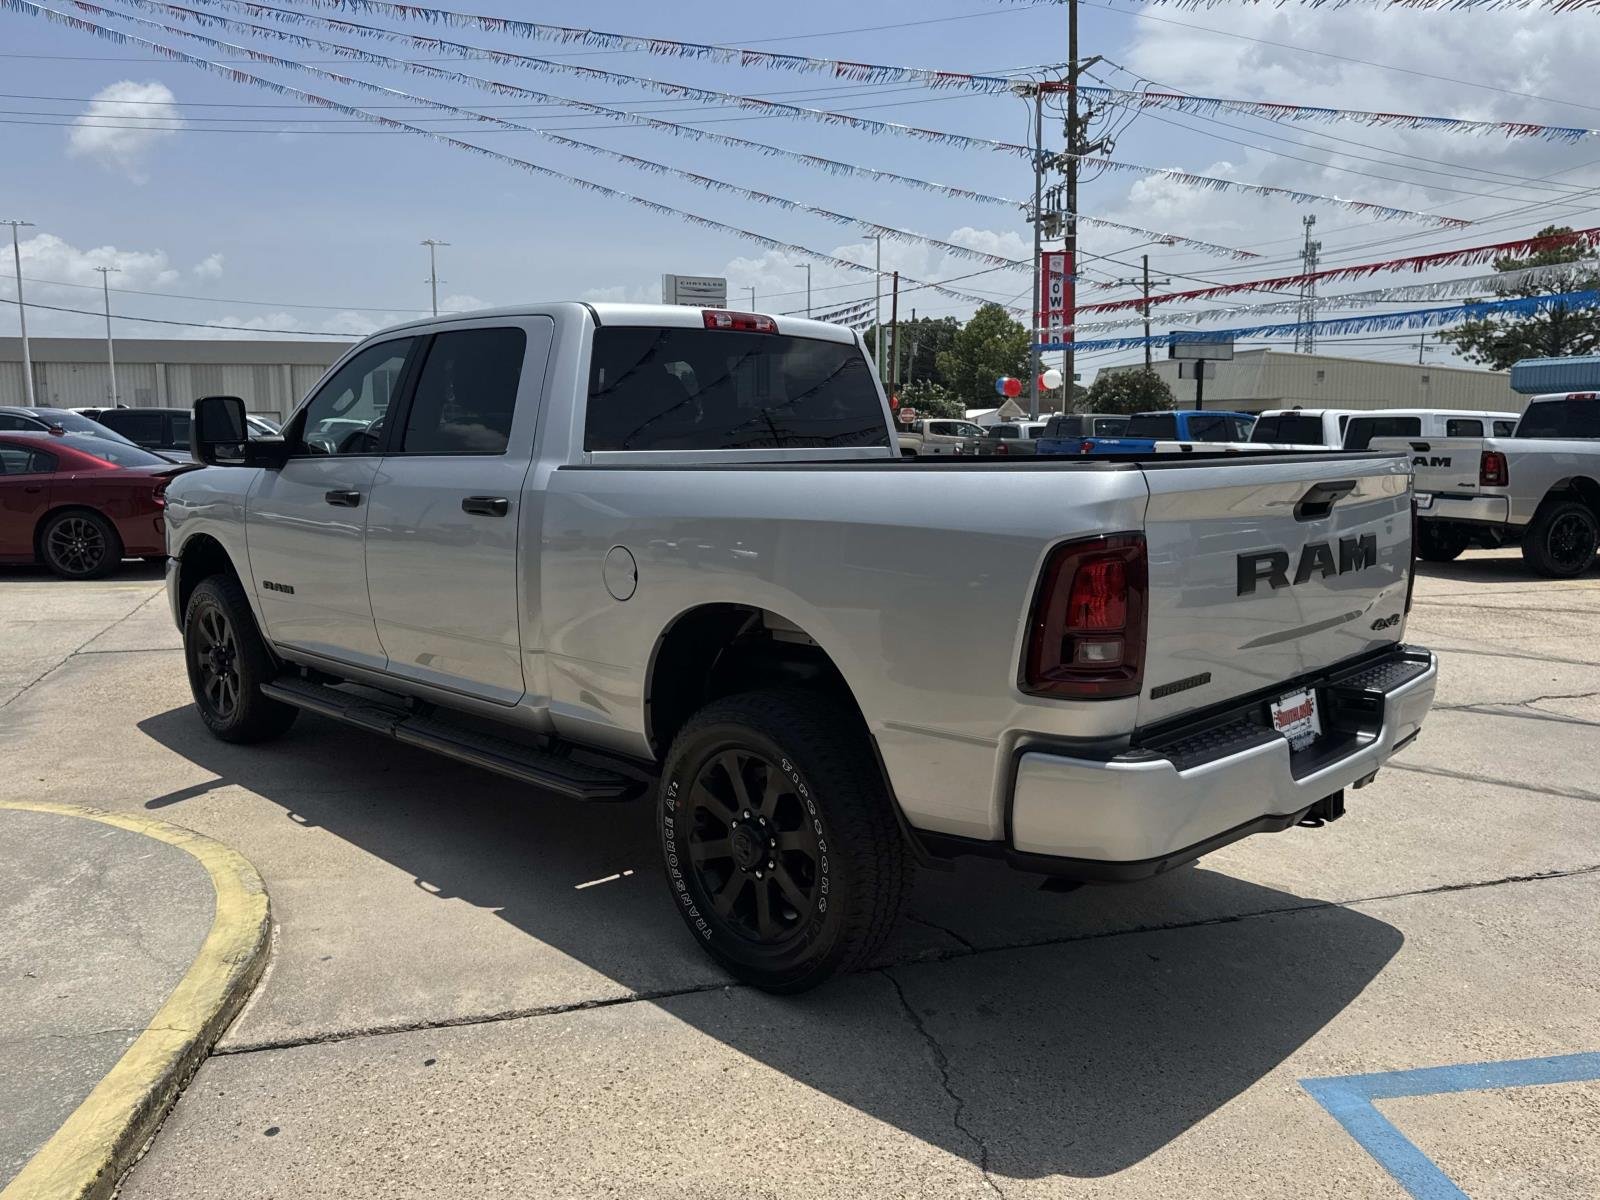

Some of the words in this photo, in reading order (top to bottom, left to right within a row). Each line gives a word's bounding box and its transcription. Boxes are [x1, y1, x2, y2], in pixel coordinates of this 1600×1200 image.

[1411, 456, 1452, 467] AM
[1236, 531, 1377, 597] RAM
[263, 580, 295, 595] RAM
[664, 815, 713, 941] TRANSFORCE
